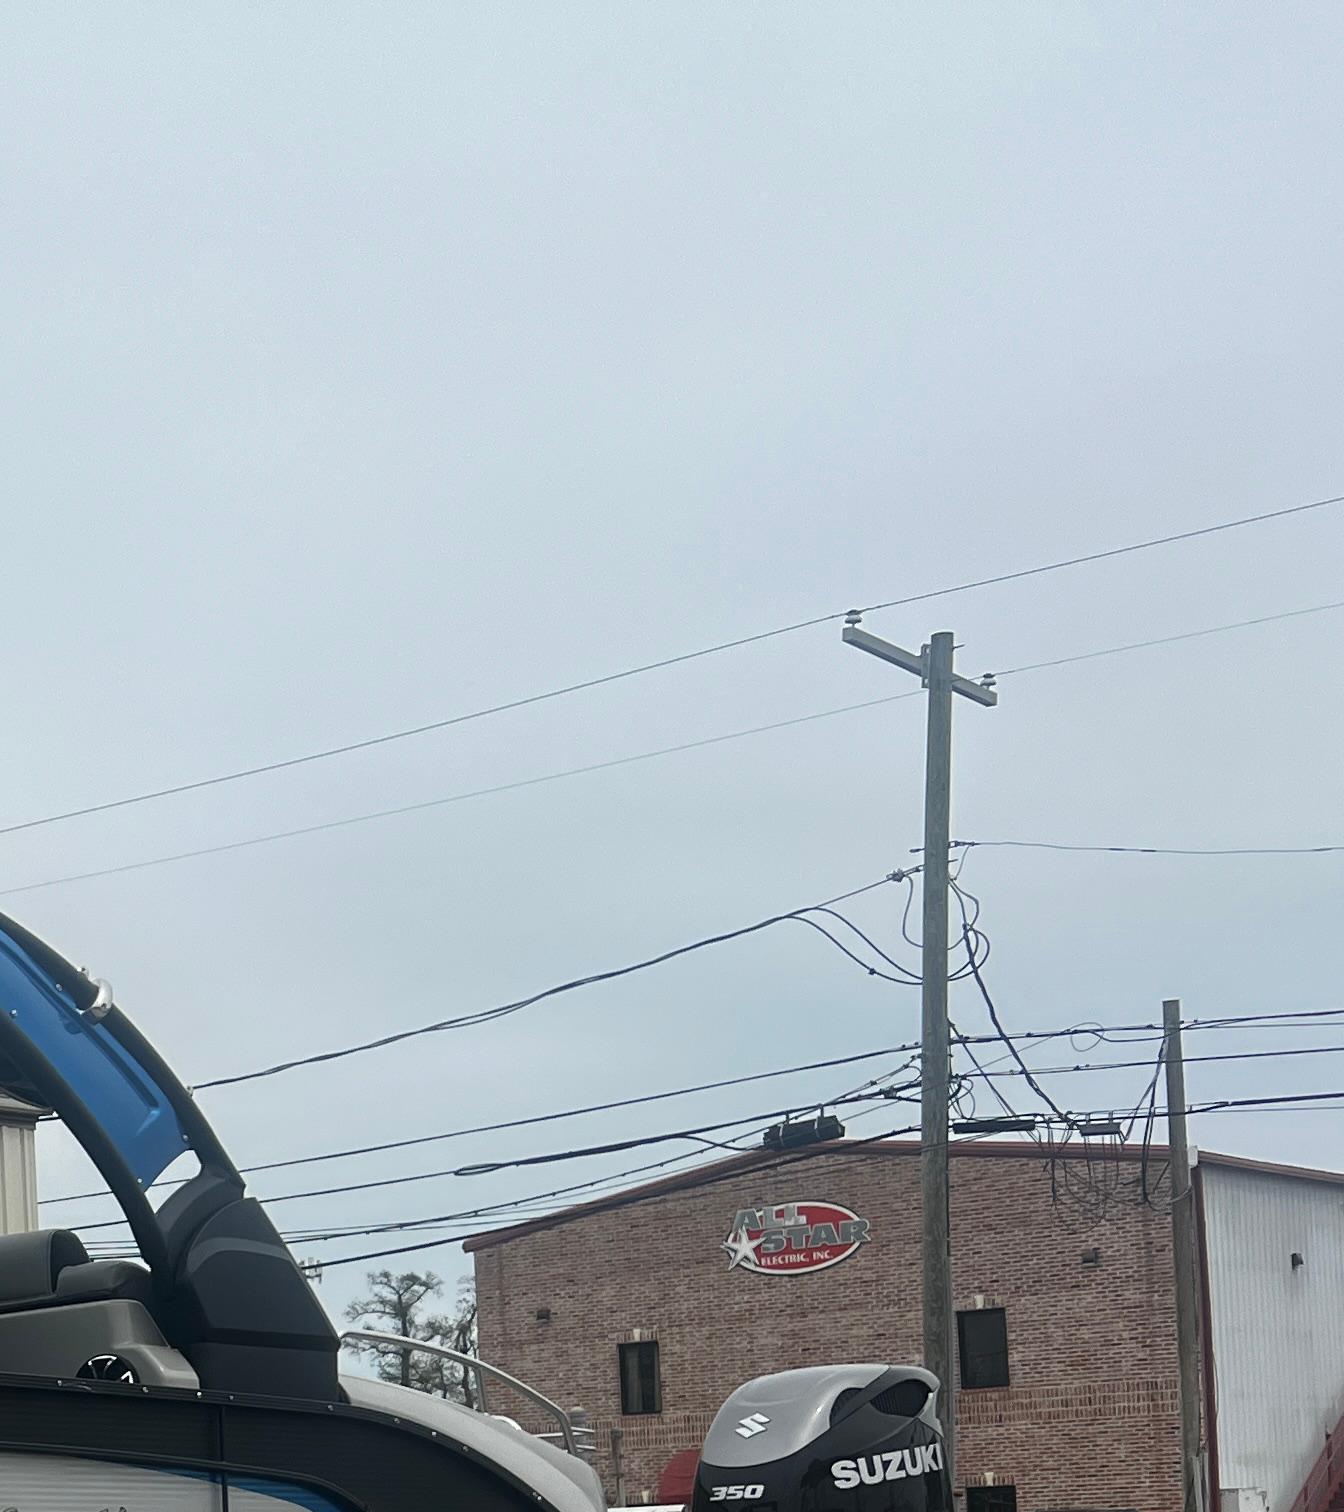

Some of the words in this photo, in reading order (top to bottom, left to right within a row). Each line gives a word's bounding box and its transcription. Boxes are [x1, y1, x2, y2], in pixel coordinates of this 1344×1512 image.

[731, 1204, 807, 1234] ALL
[760, 1218, 871, 1252] STAR
[812, 1249, 834, 1260] INC.
[831, 1443, 944, 1489] SUZUKI
[710, 1484, 765, 1501] 350
